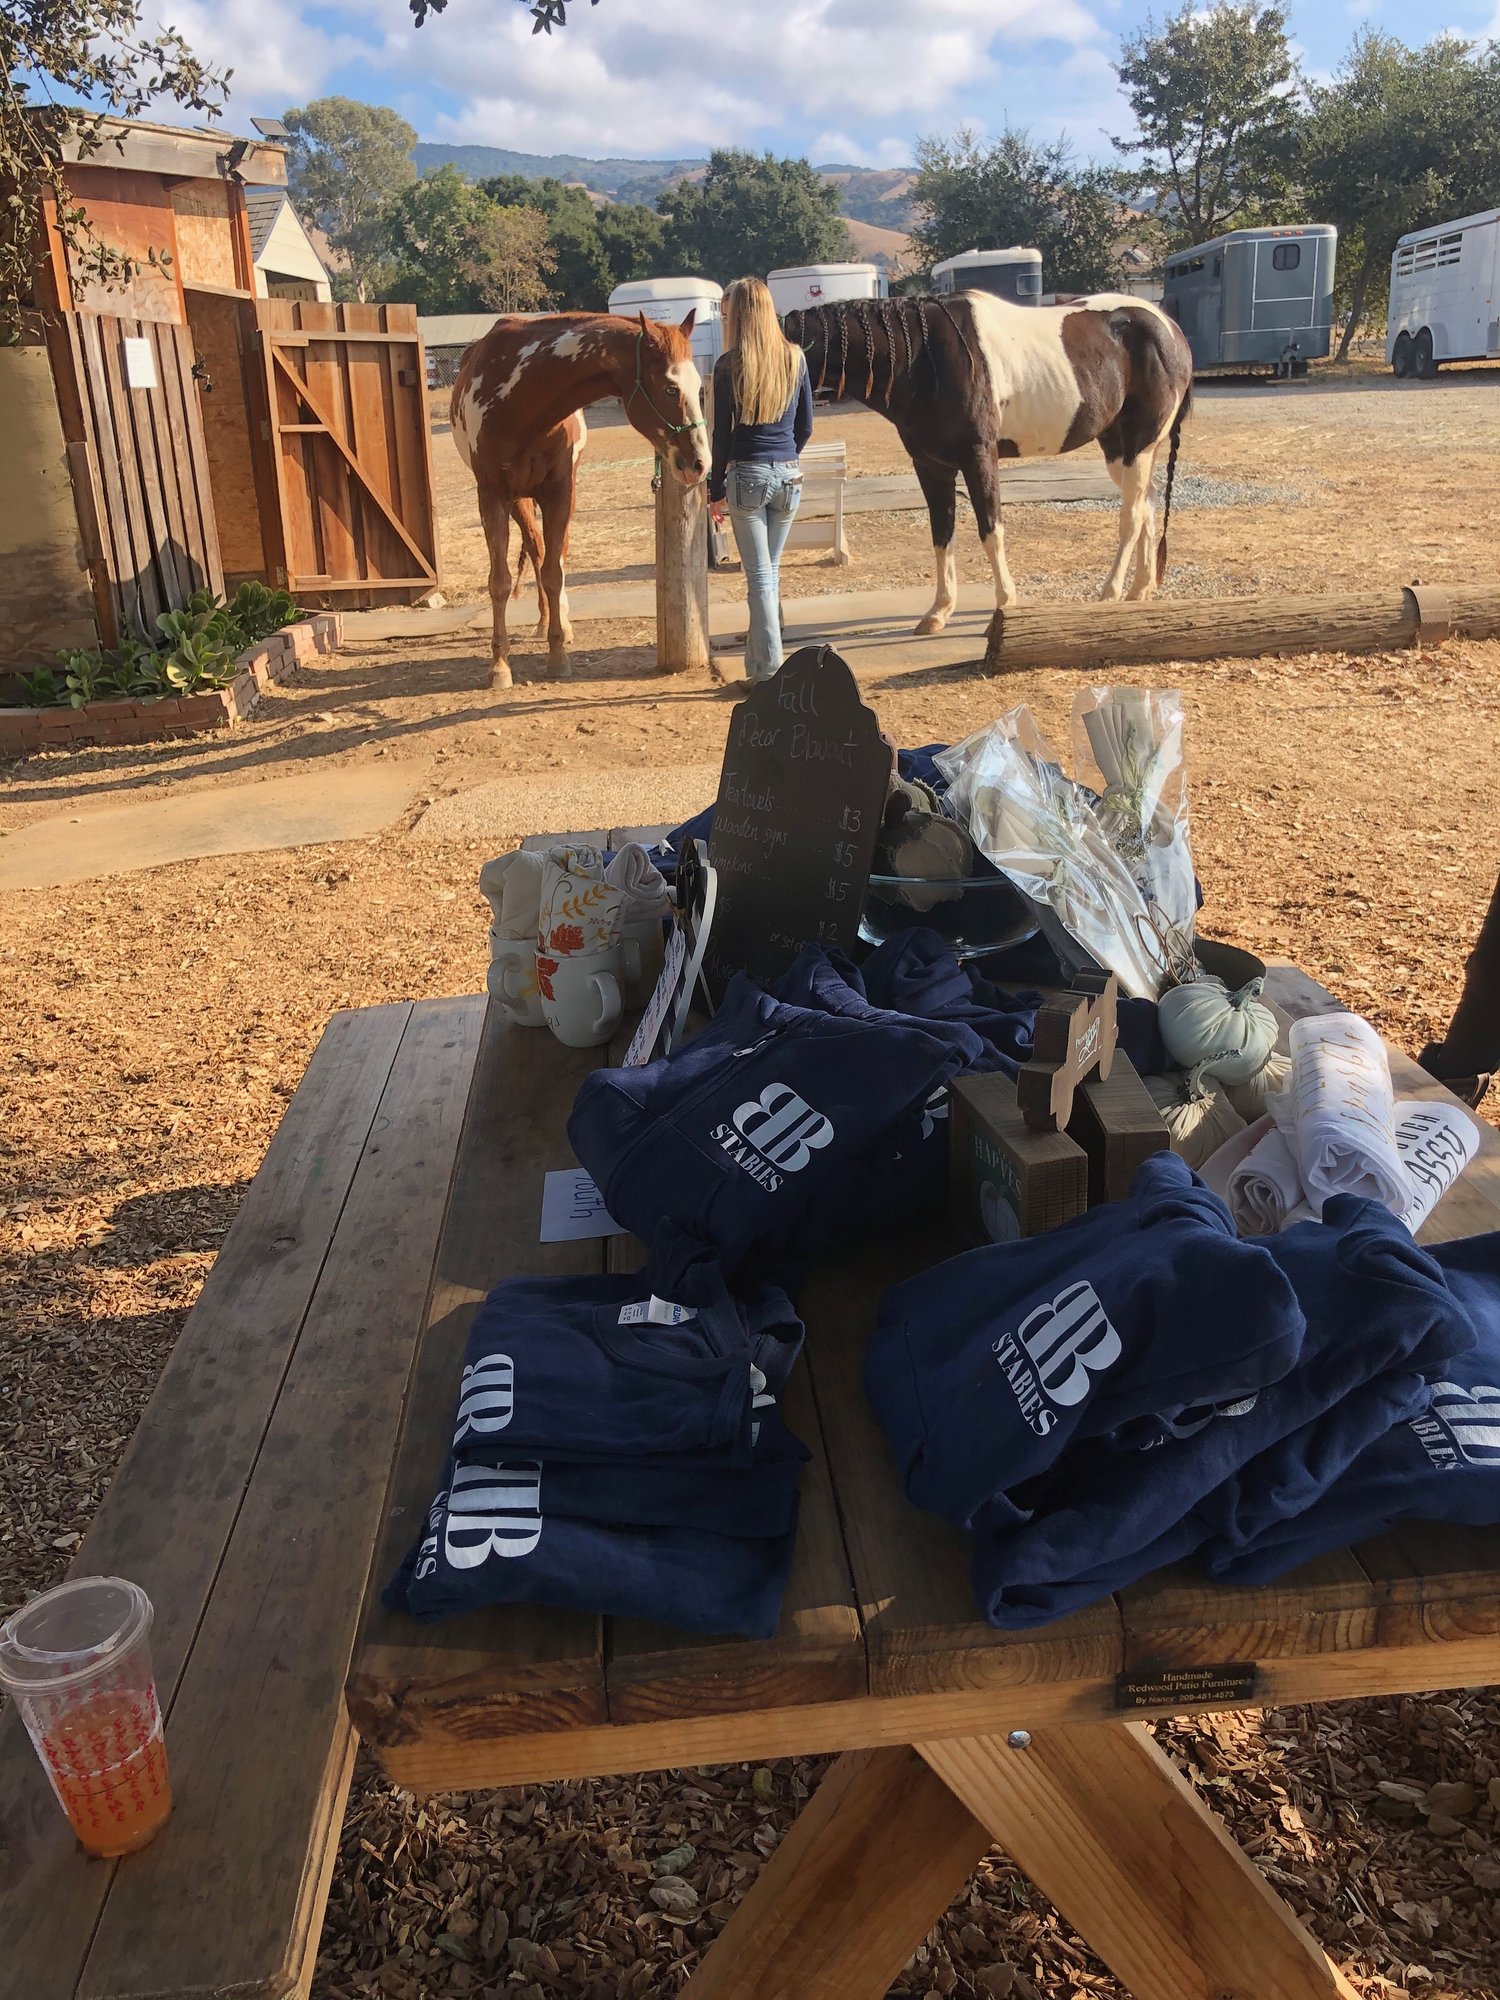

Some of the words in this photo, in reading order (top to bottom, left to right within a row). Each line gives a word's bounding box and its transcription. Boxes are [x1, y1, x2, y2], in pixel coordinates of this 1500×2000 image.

[778, 670, 820, 718] Fall
[737, 712, 783, 748] Decor
[838, 804, 862, 833] $3
[832, 841, 860, 868] $5
[824, 877, 855, 902] $5
[815, 920, 839, 942] $2
[709, 1122, 784, 1194] STABLES
[991, 1331, 1060, 1437] STABLES
[1127, 1683, 1173, 1694] Redwood
[1175, 1681, 1200, 1691] Patio
[1202, 1678, 1245, 1689] Furniture
[1162, 1671, 1213, 1683] Handmade
[1135, 1696, 1146, 1706] By
